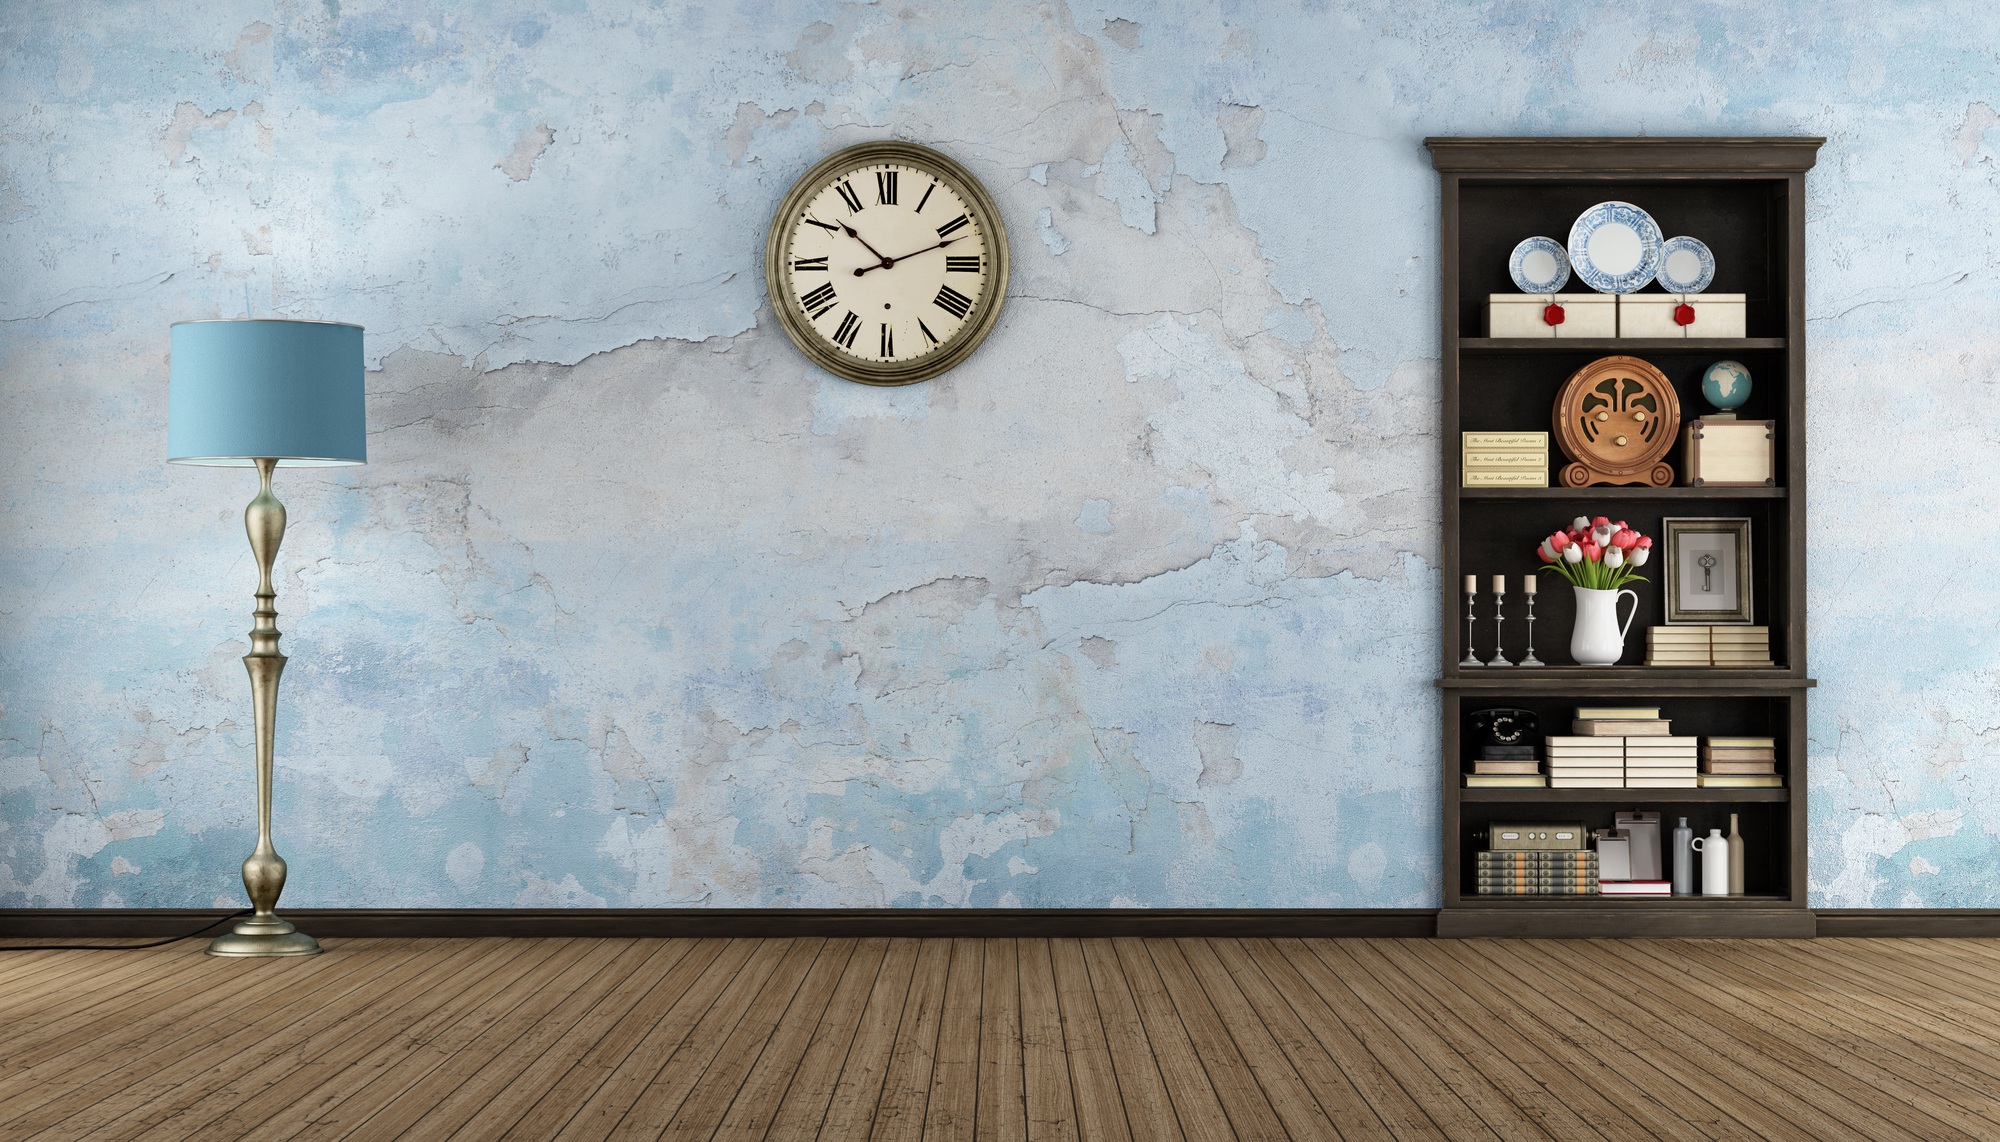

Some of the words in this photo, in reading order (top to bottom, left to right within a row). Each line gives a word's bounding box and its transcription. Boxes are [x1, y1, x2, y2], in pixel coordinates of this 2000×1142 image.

[835, 180, 865, 217] XI
[875, 171, 899, 206] XII
[914, 183, 936, 214] I
[804, 212, 841, 239] X
[935, 212, 970, 239] II
[794, 255, 829, 272] IX
[946, 255, 980, 274] III
[800, 280, 840, 321] VIII
[932, 283, 974, 321] IIII
[831, 309, 863, 350] VII
[880, 322, 895, 358] VI
[917, 316, 940, 348] V
